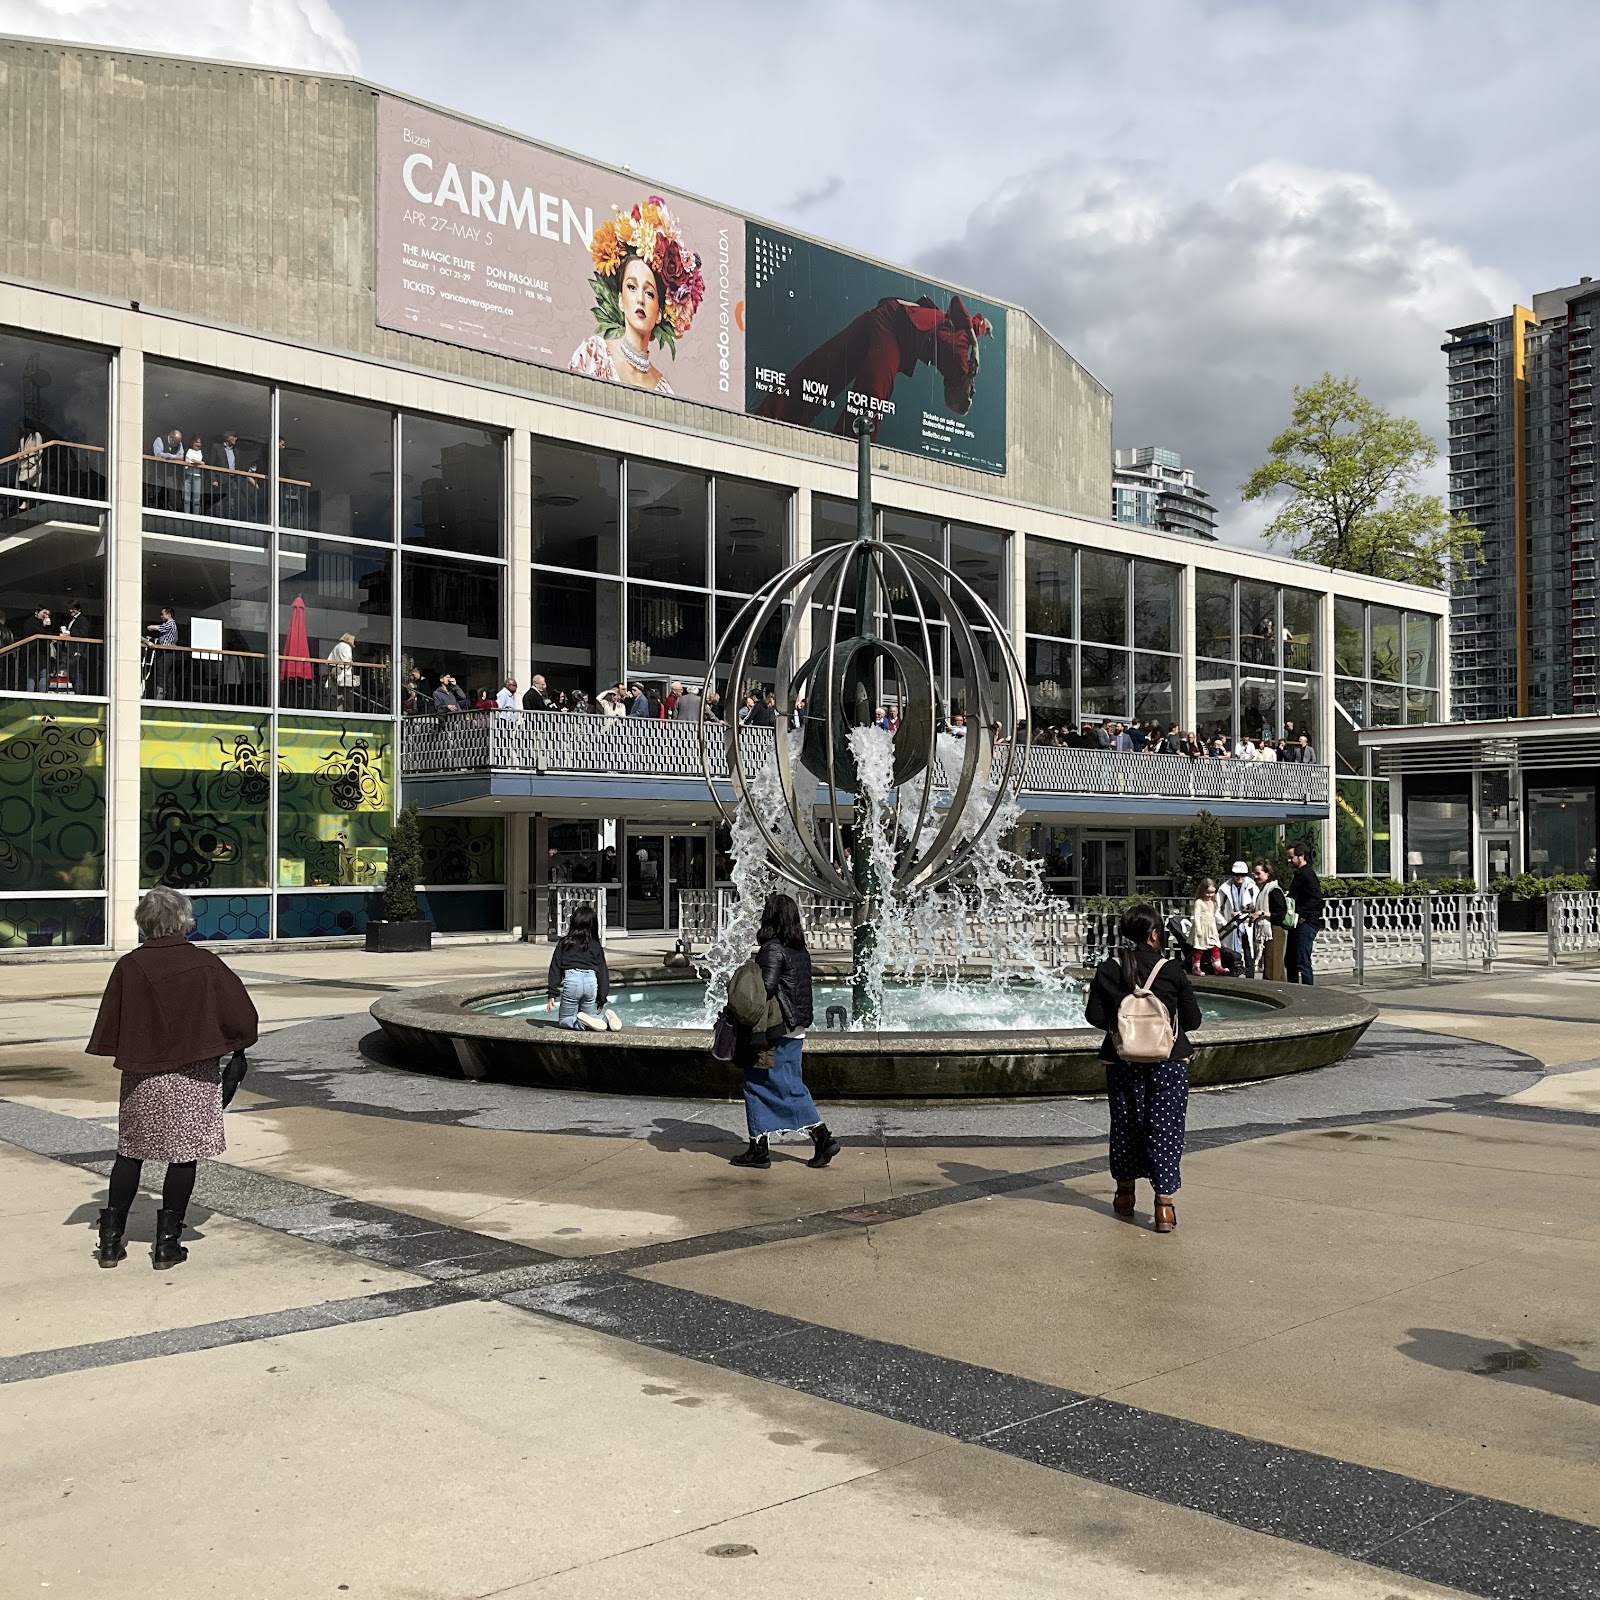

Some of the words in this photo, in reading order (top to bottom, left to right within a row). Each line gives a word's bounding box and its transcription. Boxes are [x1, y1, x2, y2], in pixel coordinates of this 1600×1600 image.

[403, 128, 431, 149] Bizet
[403, 153, 593, 252] CARMEN
[403, 209, 426, 227] APR
[485, 232, 493, 246] 5
[403, 243, 419, 256] THE
[421, 248, 451, 265] MAGIC
[453, 257, 476, 272] FLUTE
[403, 258, 429, 271] MOZART
[440, 267, 453, 277] OCT
[486, 266, 507, 280] DON
[509, 272, 549, 291] PASQUALE
[403, 279, 435, 296] TICKETS
[440, 291, 514, 316] vancouveropera.ca
[486, 280, 516, 294] DONIZETTI
[525, 290, 535, 299] FEB
[789, 290, 794, 298] C
[755, 367, 787, 387] HERE
[755, 381, 769, 392] Nov
[803, 379, 829, 397] NOW
[803, 393, 814, 403] Mar
[847, 391, 868, 408] FOR
[870, 397, 896, 415] EVER
[847, 404, 860, 417] May
